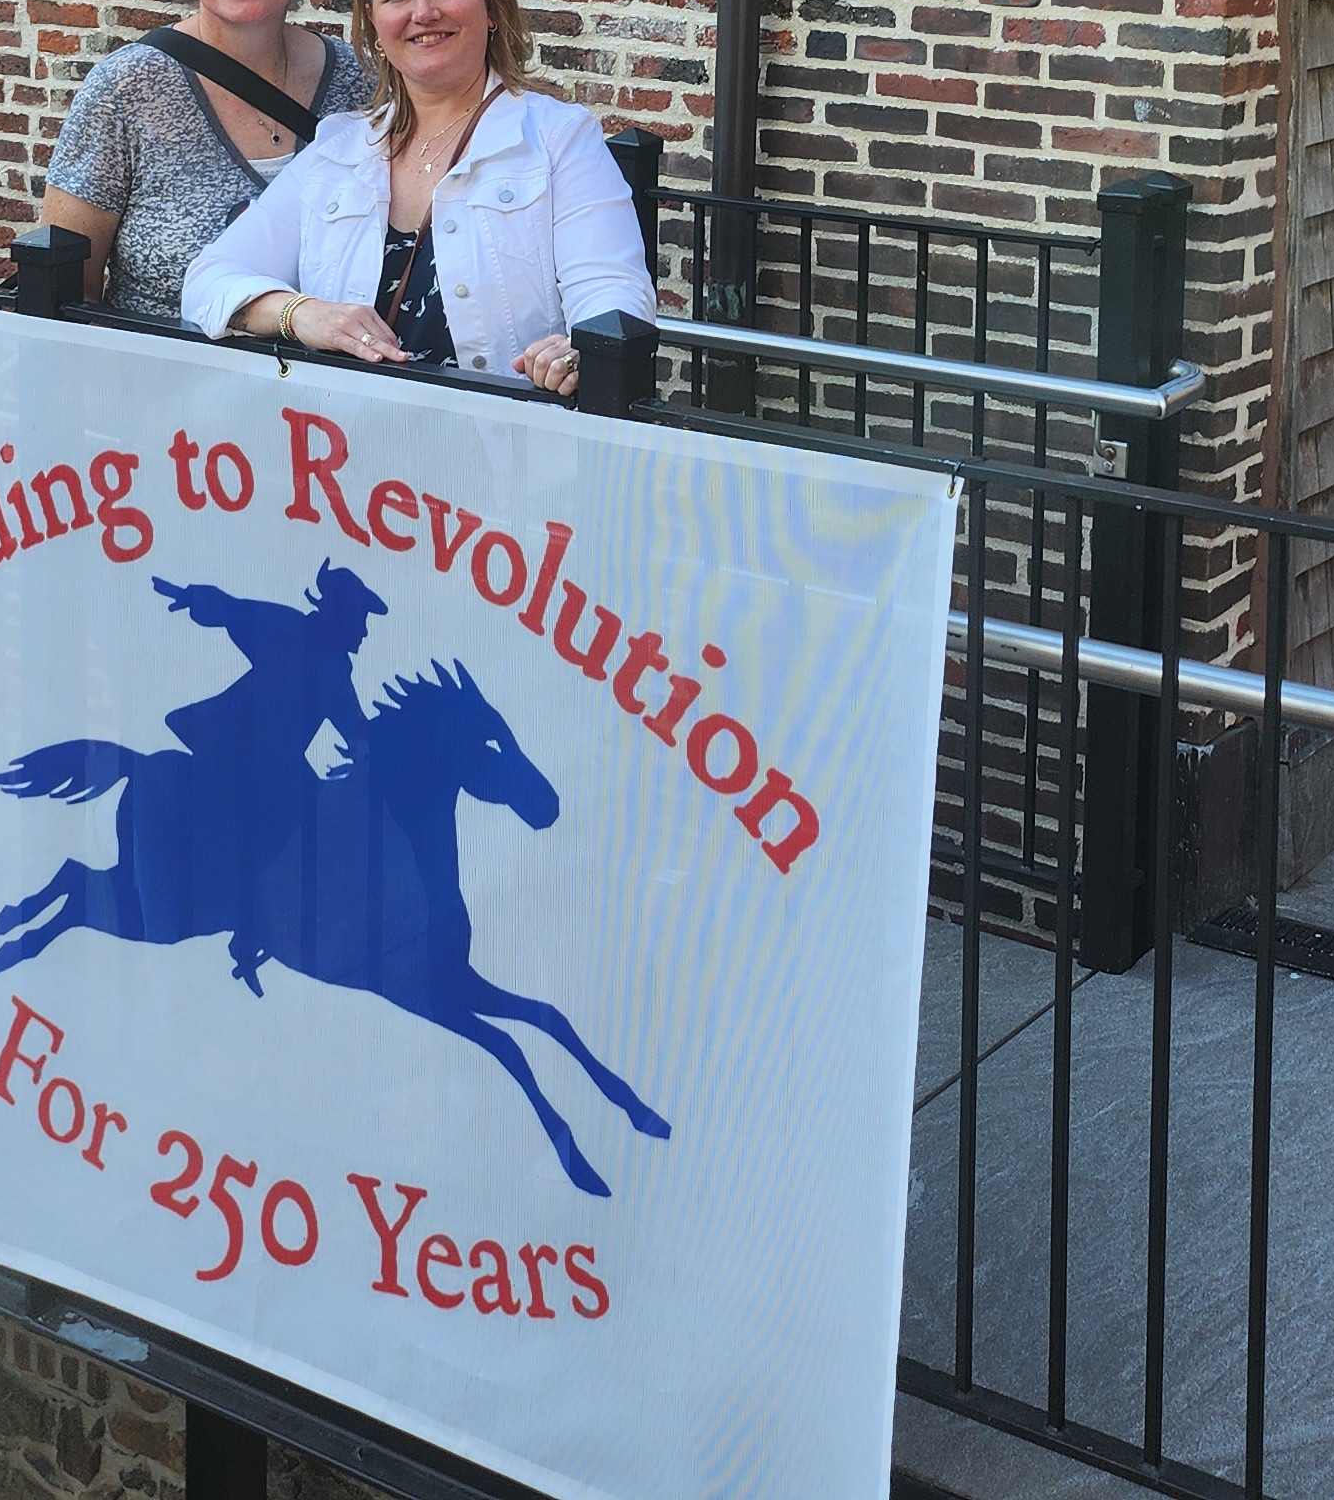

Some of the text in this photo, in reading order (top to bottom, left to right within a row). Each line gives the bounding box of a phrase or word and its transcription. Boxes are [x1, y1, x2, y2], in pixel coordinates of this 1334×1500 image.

[168, 429, 255, 513] to
[281, 407, 821, 875] Revolution
[149, 1129, 318, 1282] 250
[347, 1173, 610, 1319] Years
